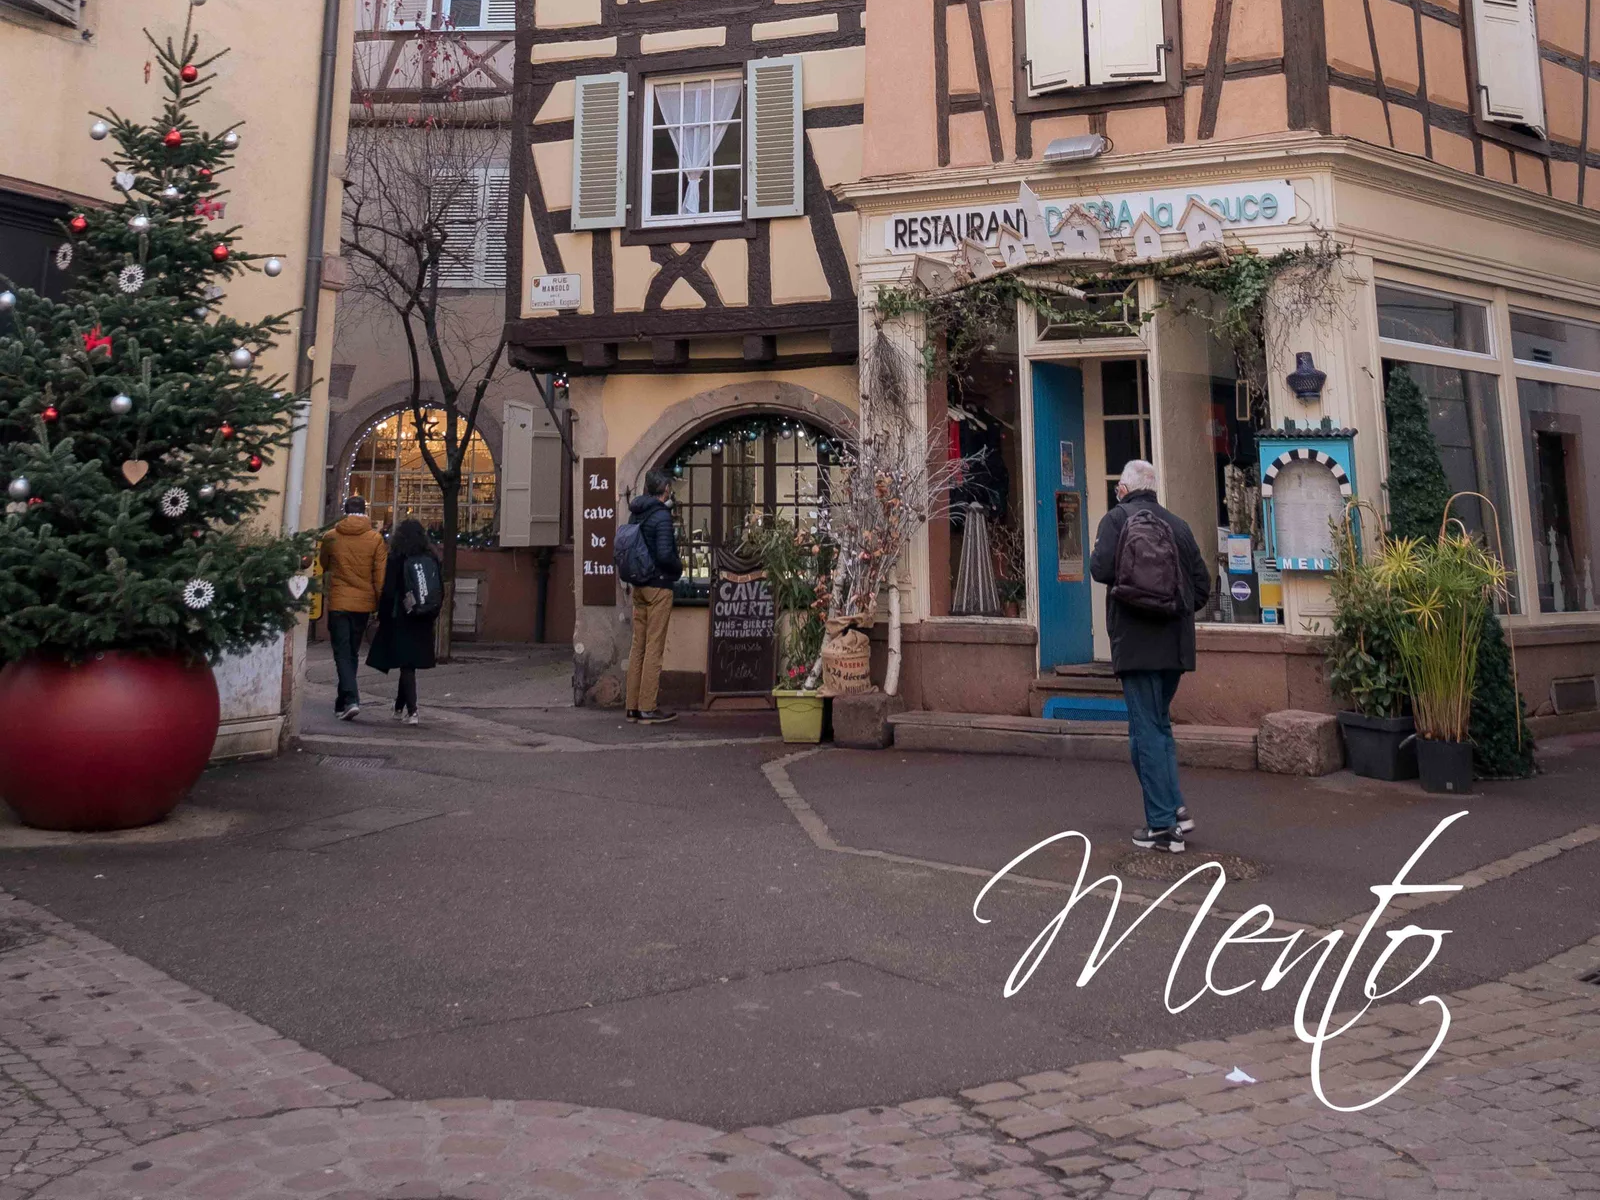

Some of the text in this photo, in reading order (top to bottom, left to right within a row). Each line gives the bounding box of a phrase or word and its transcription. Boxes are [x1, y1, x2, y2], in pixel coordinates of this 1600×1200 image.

[1149, 196, 1173, 228] la
[589, 473, 609, 491] La
[583, 505, 615, 519] cave
[590, 532, 607, 548] de
[583, 560, 615, 575] Lina
[719, 580, 772, 601] CAVE
[715, 601, 774, 617] OUVERTE
